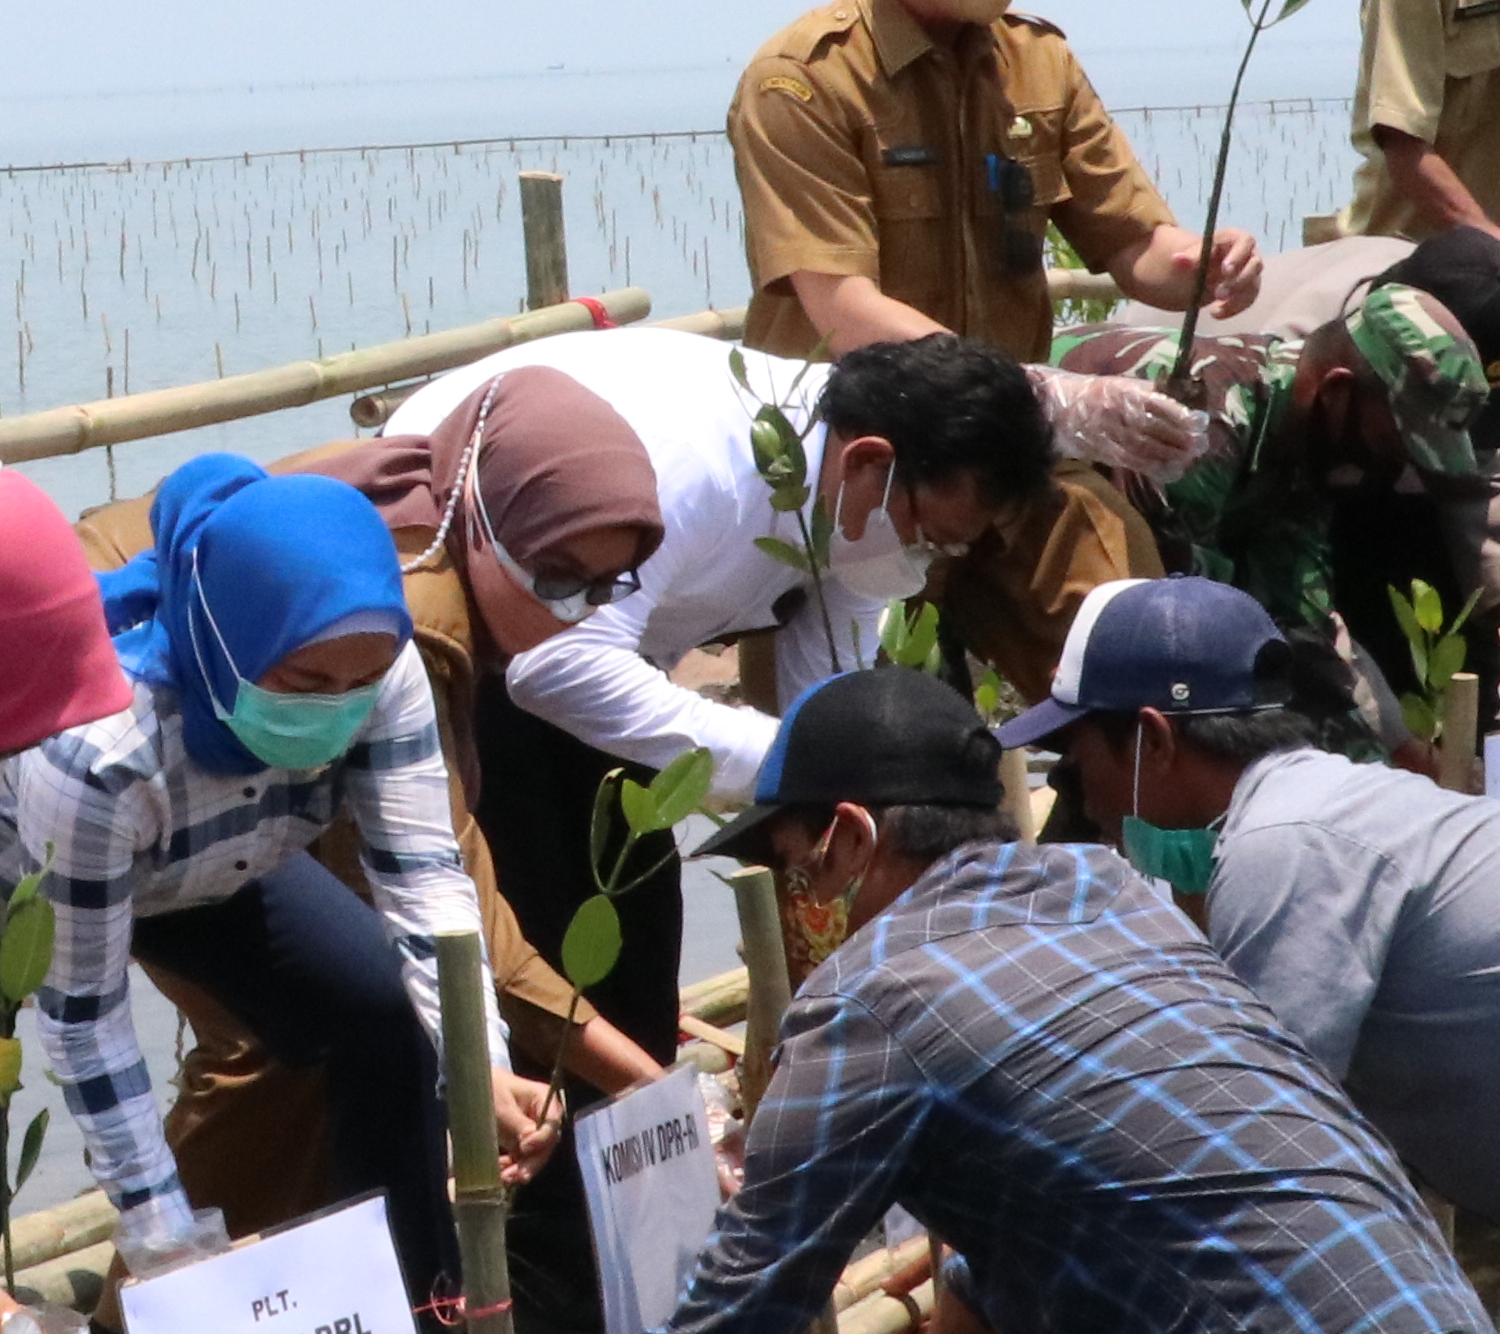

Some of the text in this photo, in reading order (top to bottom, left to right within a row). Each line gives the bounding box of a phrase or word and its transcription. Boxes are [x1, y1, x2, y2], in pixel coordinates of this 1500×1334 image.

[642, 1128, 655, 1166] IV
[656, 1114, 699, 1162] DPR-RI
[252, 1289, 297, 1321] PLT.
